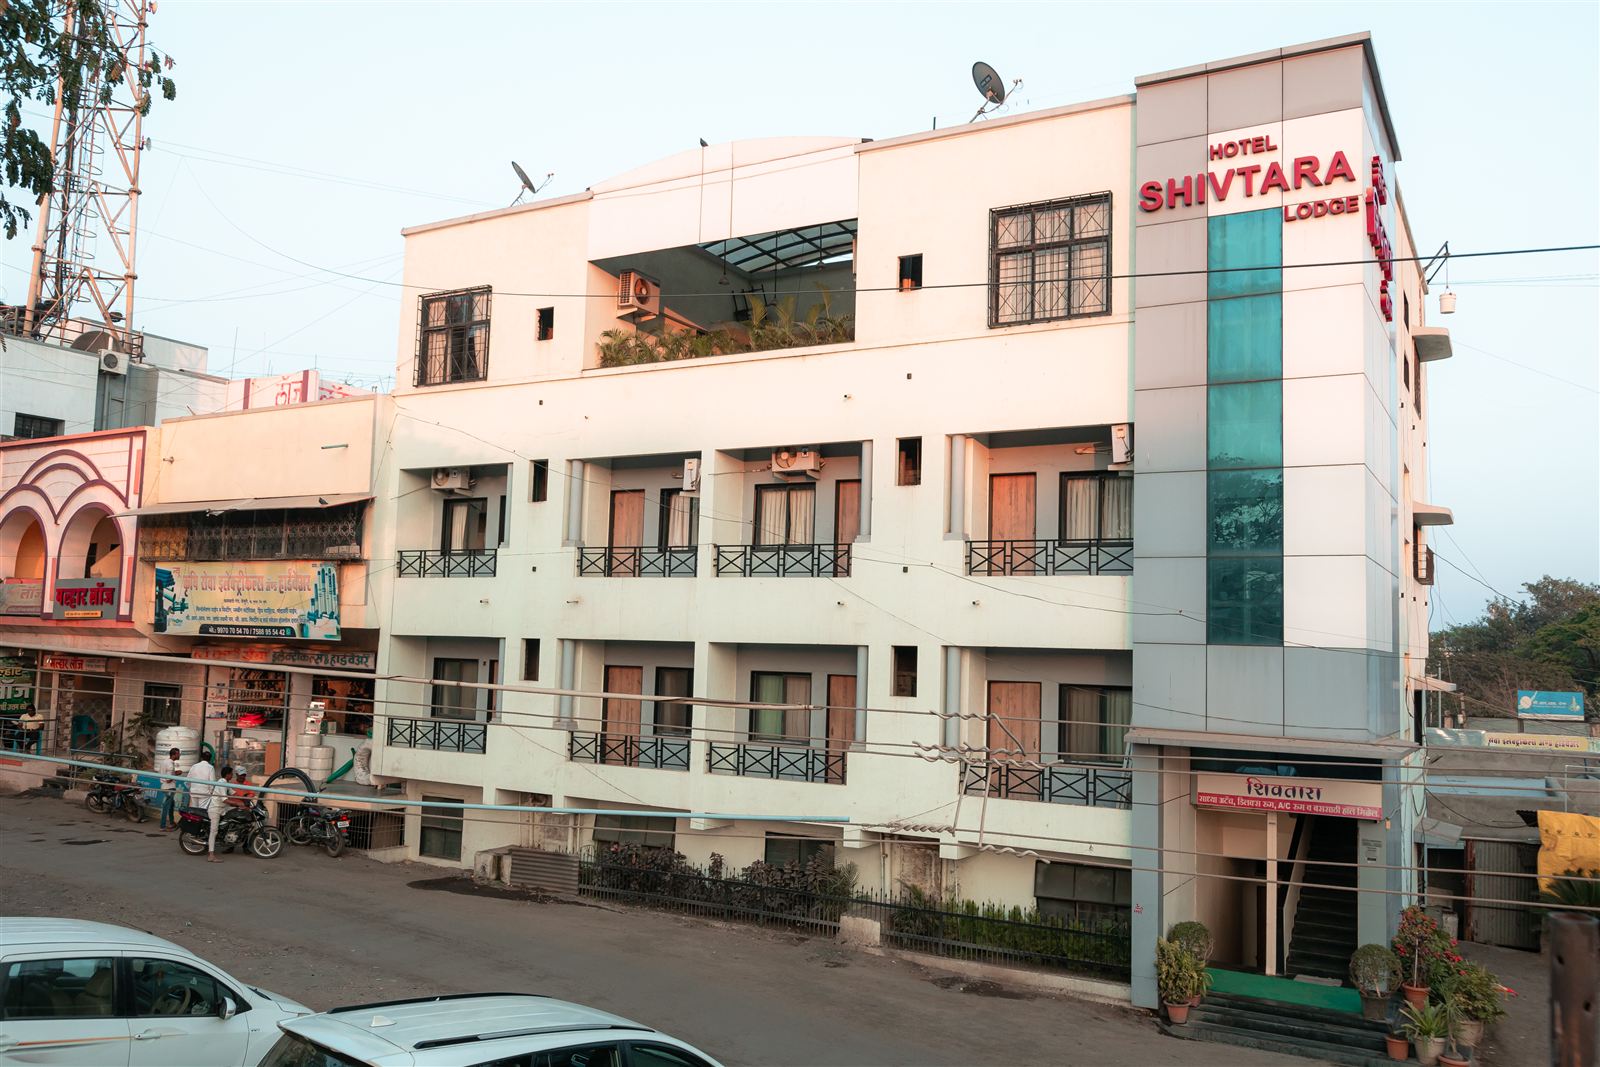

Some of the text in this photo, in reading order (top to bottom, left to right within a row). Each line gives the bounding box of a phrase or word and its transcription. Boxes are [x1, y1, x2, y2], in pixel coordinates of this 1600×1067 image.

[1209, 135, 1278, 161] HOTEL
[1138, 150, 1356, 212] SHIVTARA
[1284, 195, 1360, 222] LODGE
[201, 570, 216, 591] सेवा
[89, 582, 116, 606] लॉज
[1246, 776, 1323, 800] शिवतारा
